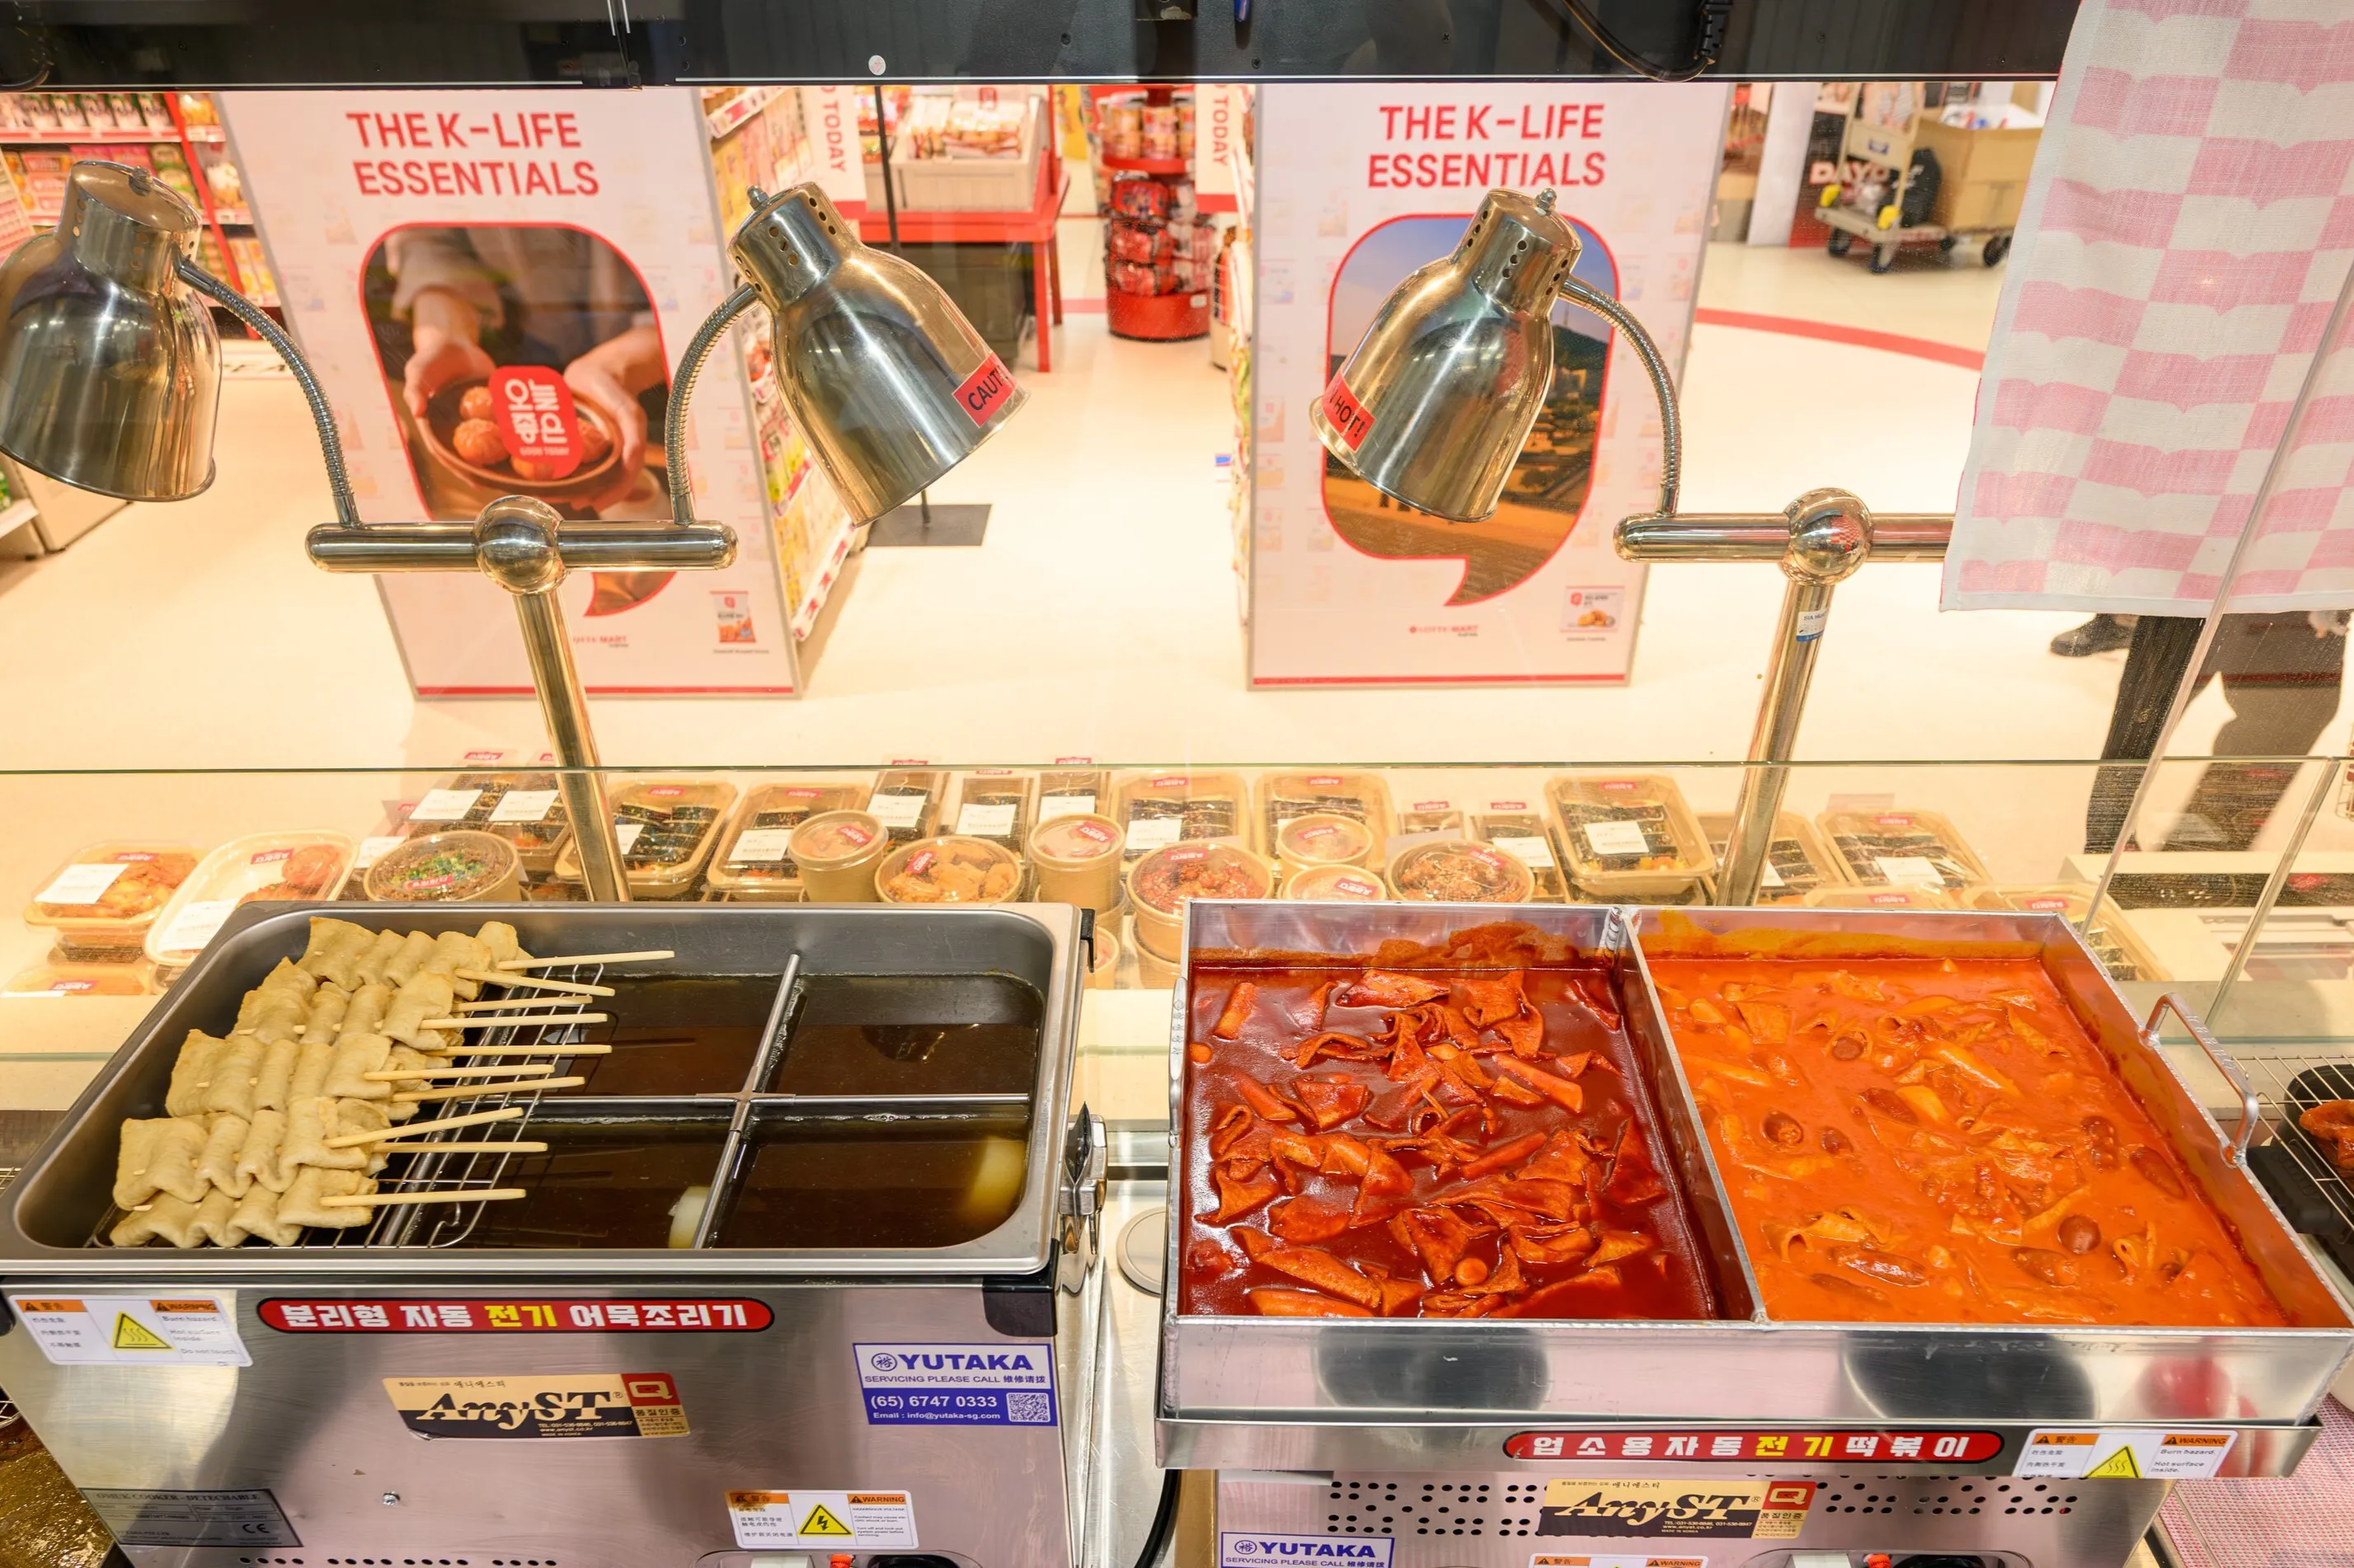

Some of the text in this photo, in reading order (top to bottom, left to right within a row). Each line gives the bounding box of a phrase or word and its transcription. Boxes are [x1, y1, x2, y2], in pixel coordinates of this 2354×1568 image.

[345, 112, 432, 148] THE
[822, 100, 846, 172] TODAY
[1213, 95, 1229, 166] TODAY
[1379, 105, 1456, 140] THE
[352, 161, 599, 196] ESSENTIALS
[1368, 152, 1606, 188] ESSENTIALS
[1332, 395, 1365, 438] HOT!
[280, 1304, 747, 1327] 분리형 자동 전기 어묵조리기
[899, 1354, 1034, 1370] YUTAKA
[416, 1391, 610, 1430] AnyST
[871, 1395, 998, 1410] (65) 6747 0333
[907, 1412, 1000, 1420] info@yutaka-sg.com
[1554, 1491, 1750, 1525] AnyST
[1259, 1542, 1376, 1558] YUTAKA
